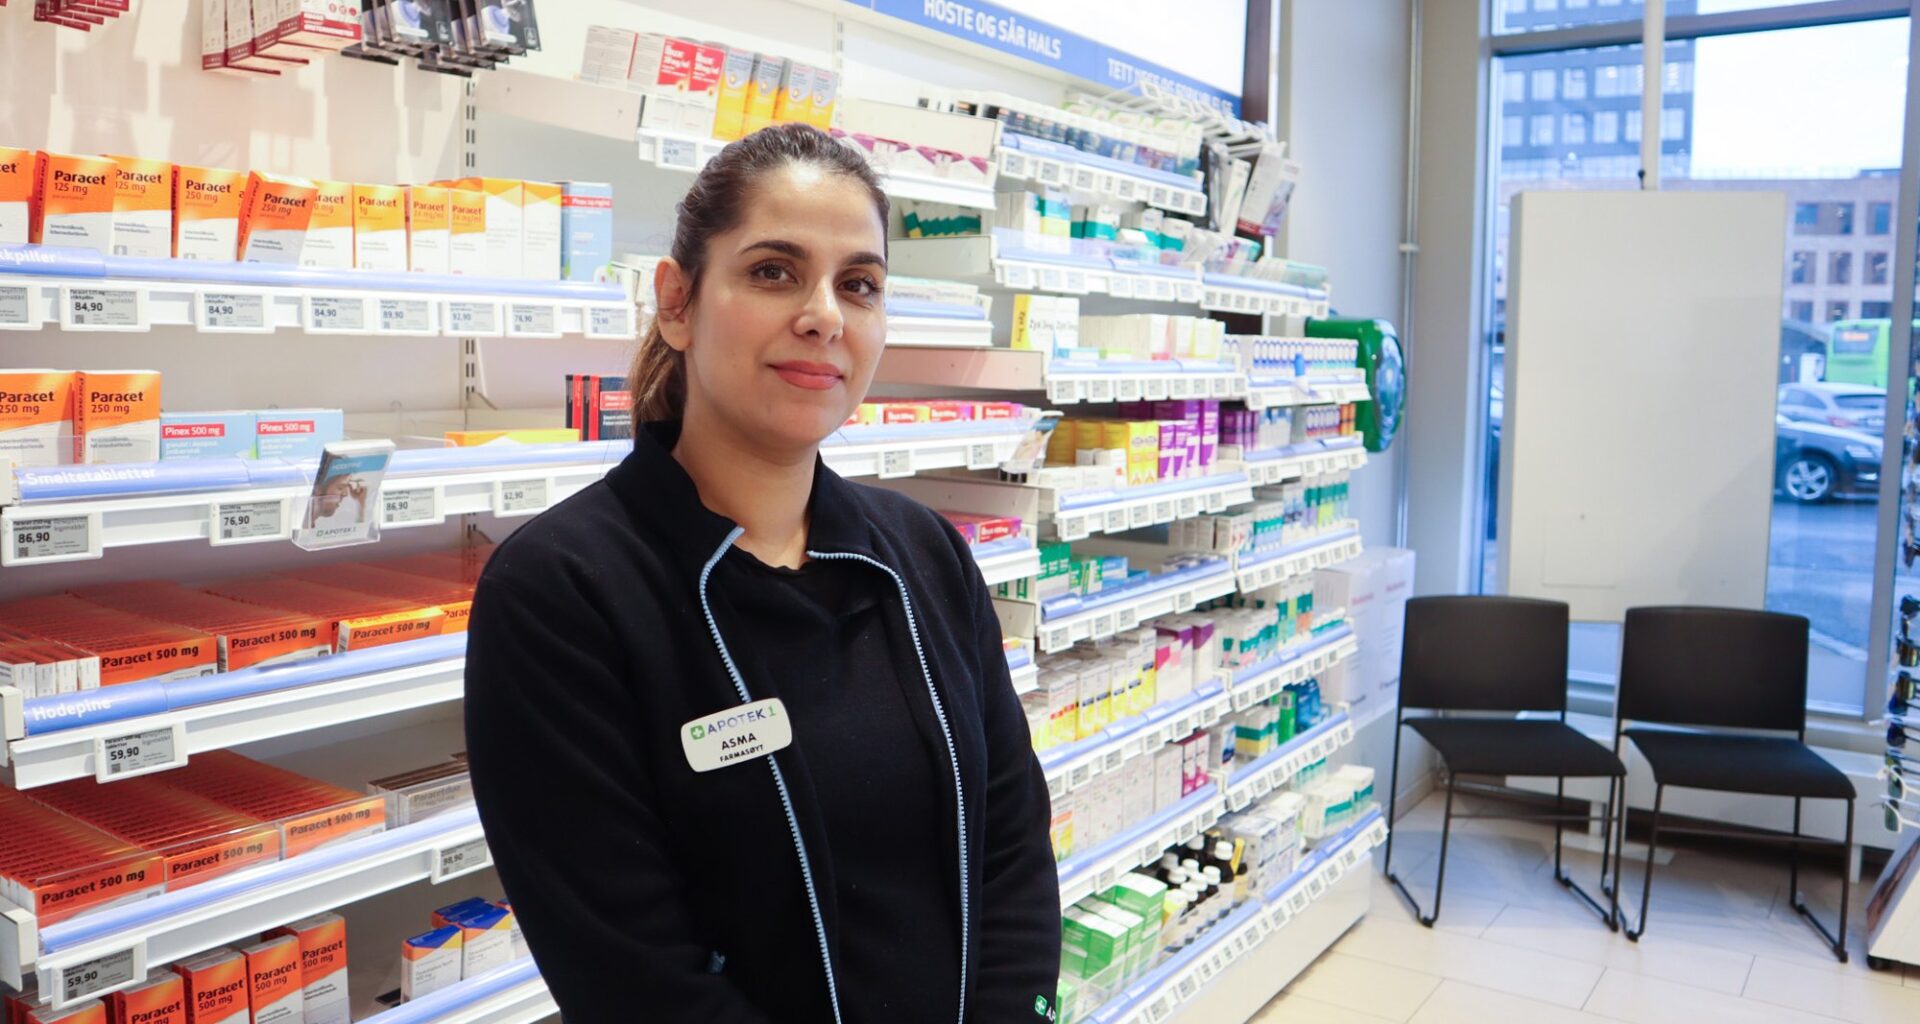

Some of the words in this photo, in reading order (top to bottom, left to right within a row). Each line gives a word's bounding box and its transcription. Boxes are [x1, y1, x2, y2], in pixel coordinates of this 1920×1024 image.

[975, 11, 997, 38] OG
[997, 16, 1026, 48] SÅR
[1027, 29, 1062, 59] HALS
[1107, 58, 1135, 83] TETT
[54, 170, 106, 185] Paracet
[115, 169, 162, 184] Paracet
[54, 183, 69, 192] 125
[72, 185, 88, 195] mg
[115, 182, 130, 190] 125
[132, 184, 146, 193] mg
[186, 179, 231, 193] Paracet
[185, 191, 201, 200] 250
[204, 193, 218, 204] mg
[264, 193, 306, 208] Paracet
[314, 193, 345, 204] racet
[359, 195, 397, 208] Paracet
[261, 204, 277, 213] 250
[279, 206, 292, 215] mg
[413, 201, 444, 211] Paracet
[452, 205, 482, 215] Paracet
[74, 302, 103, 313] 84,90
[208, 305, 233, 316] 84,90
[314, 308, 337, 318] 84,90
[0, 390, 55, 402] Paracet
[91, 391, 144, 403] Paracet
[0, 404, 18, 414] 250
[23, 405, 40, 415] mg
[91, 404, 110, 413] 250
[113, 405, 130, 415] mg
[165, 427, 190, 436] Pinex
[192, 426, 207, 435] 500
[208, 428, 221, 437] mg
[260, 423, 283, 432] Pinex
[284, 422, 298, 431] 500
[299, 424, 310, 433] mg
[24, 467, 157, 486] Smeltetabletter
[386, 501, 408, 511] 86,90
[224, 516, 250, 526] 76,90
[18, 532, 50, 545] 86,90
[444, 609, 470, 618] Parac
[353, 626, 394, 639] Paracet
[396, 622, 413, 632] 500
[415, 621, 430, 630] mg
[231, 634, 275, 648] Paracet
[279, 630, 298, 641] 500
[301, 628, 316, 638] mg
[102, 653, 152, 668] Paracet
[156, 648, 177, 659] 500
[181, 645, 199, 657] mg
[32, 698, 113, 721] Hodepine
[707, 708, 767, 734] APOTEK
[768, 705, 776, 717] 1
[722, 732, 757, 750] ASMA
[110, 747, 139, 761] 59,90
[720, 744, 764, 763] FARMASØYT
[290, 818, 333, 836] Paracet
[335, 812, 354, 826] 500
[355, 807, 370, 821] mg
[172, 853, 220, 874] Paracet
[223, 847, 243, 860] 500
[246, 843, 263, 854] mg
[41, 880, 96, 905] Paracet
[99, 877, 122, 891] 500
[126, 869, 145, 882] mg
[302, 940, 344, 961] Paracet
[302, 958, 318, 969] 500
[320, 953, 333, 964] mg
[67, 970, 98, 988] 59,90
[254, 961, 297, 983] Paracet
[197, 979, 244, 1002] Paracet
[255, 981, 271, 992] 500
[274, 975, 288, 986] mg
[198, 999, 216, 1012] 500
[218, 993, 233, 1005] mg
[131, 1001, 181, 1024] Paracet
